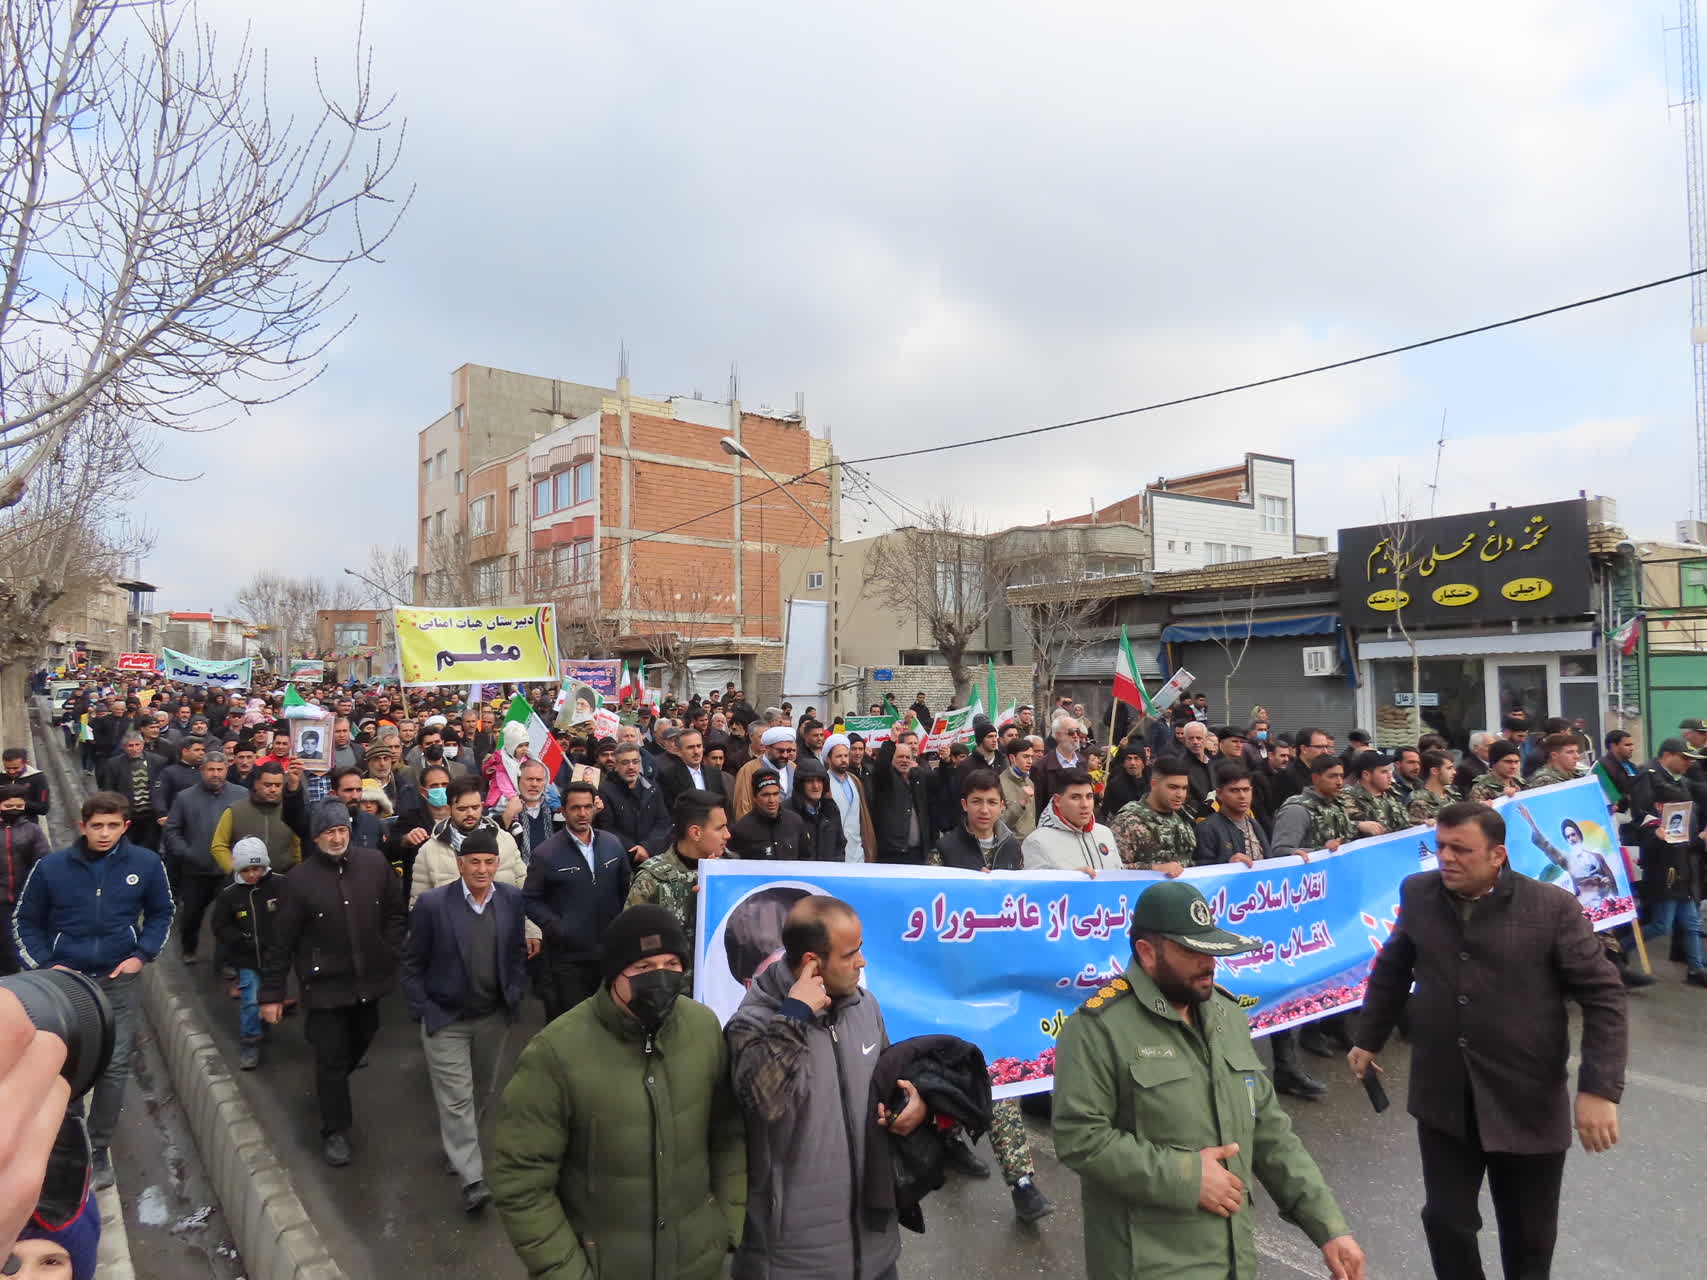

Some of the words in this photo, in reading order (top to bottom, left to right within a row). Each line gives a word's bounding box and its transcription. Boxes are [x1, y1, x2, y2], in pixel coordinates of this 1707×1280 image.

[1480, 520, 1513, 561] داغ
[1520, 515, 1550, 551] تخمه
[1419, 533, 1477, 576] محلی
[418, 617, 453, 631] امنایی
[456, 616, 482, 631] هیأت
[486, 615, 534, 631] دبیرستان
[173, 665, 200, 676] علم
[436, 636, 521, 672] معلم
[1228, 879, 1288, 923] اسلامی
[1291, 871, 1325, 911] انقلاب
[903, 909, 926, 940] و
[933, 893, 1041, 941] عاشورا
[1048, 895, 1068, 939] از
[1280, 920, 1334, 966] انقلاب
